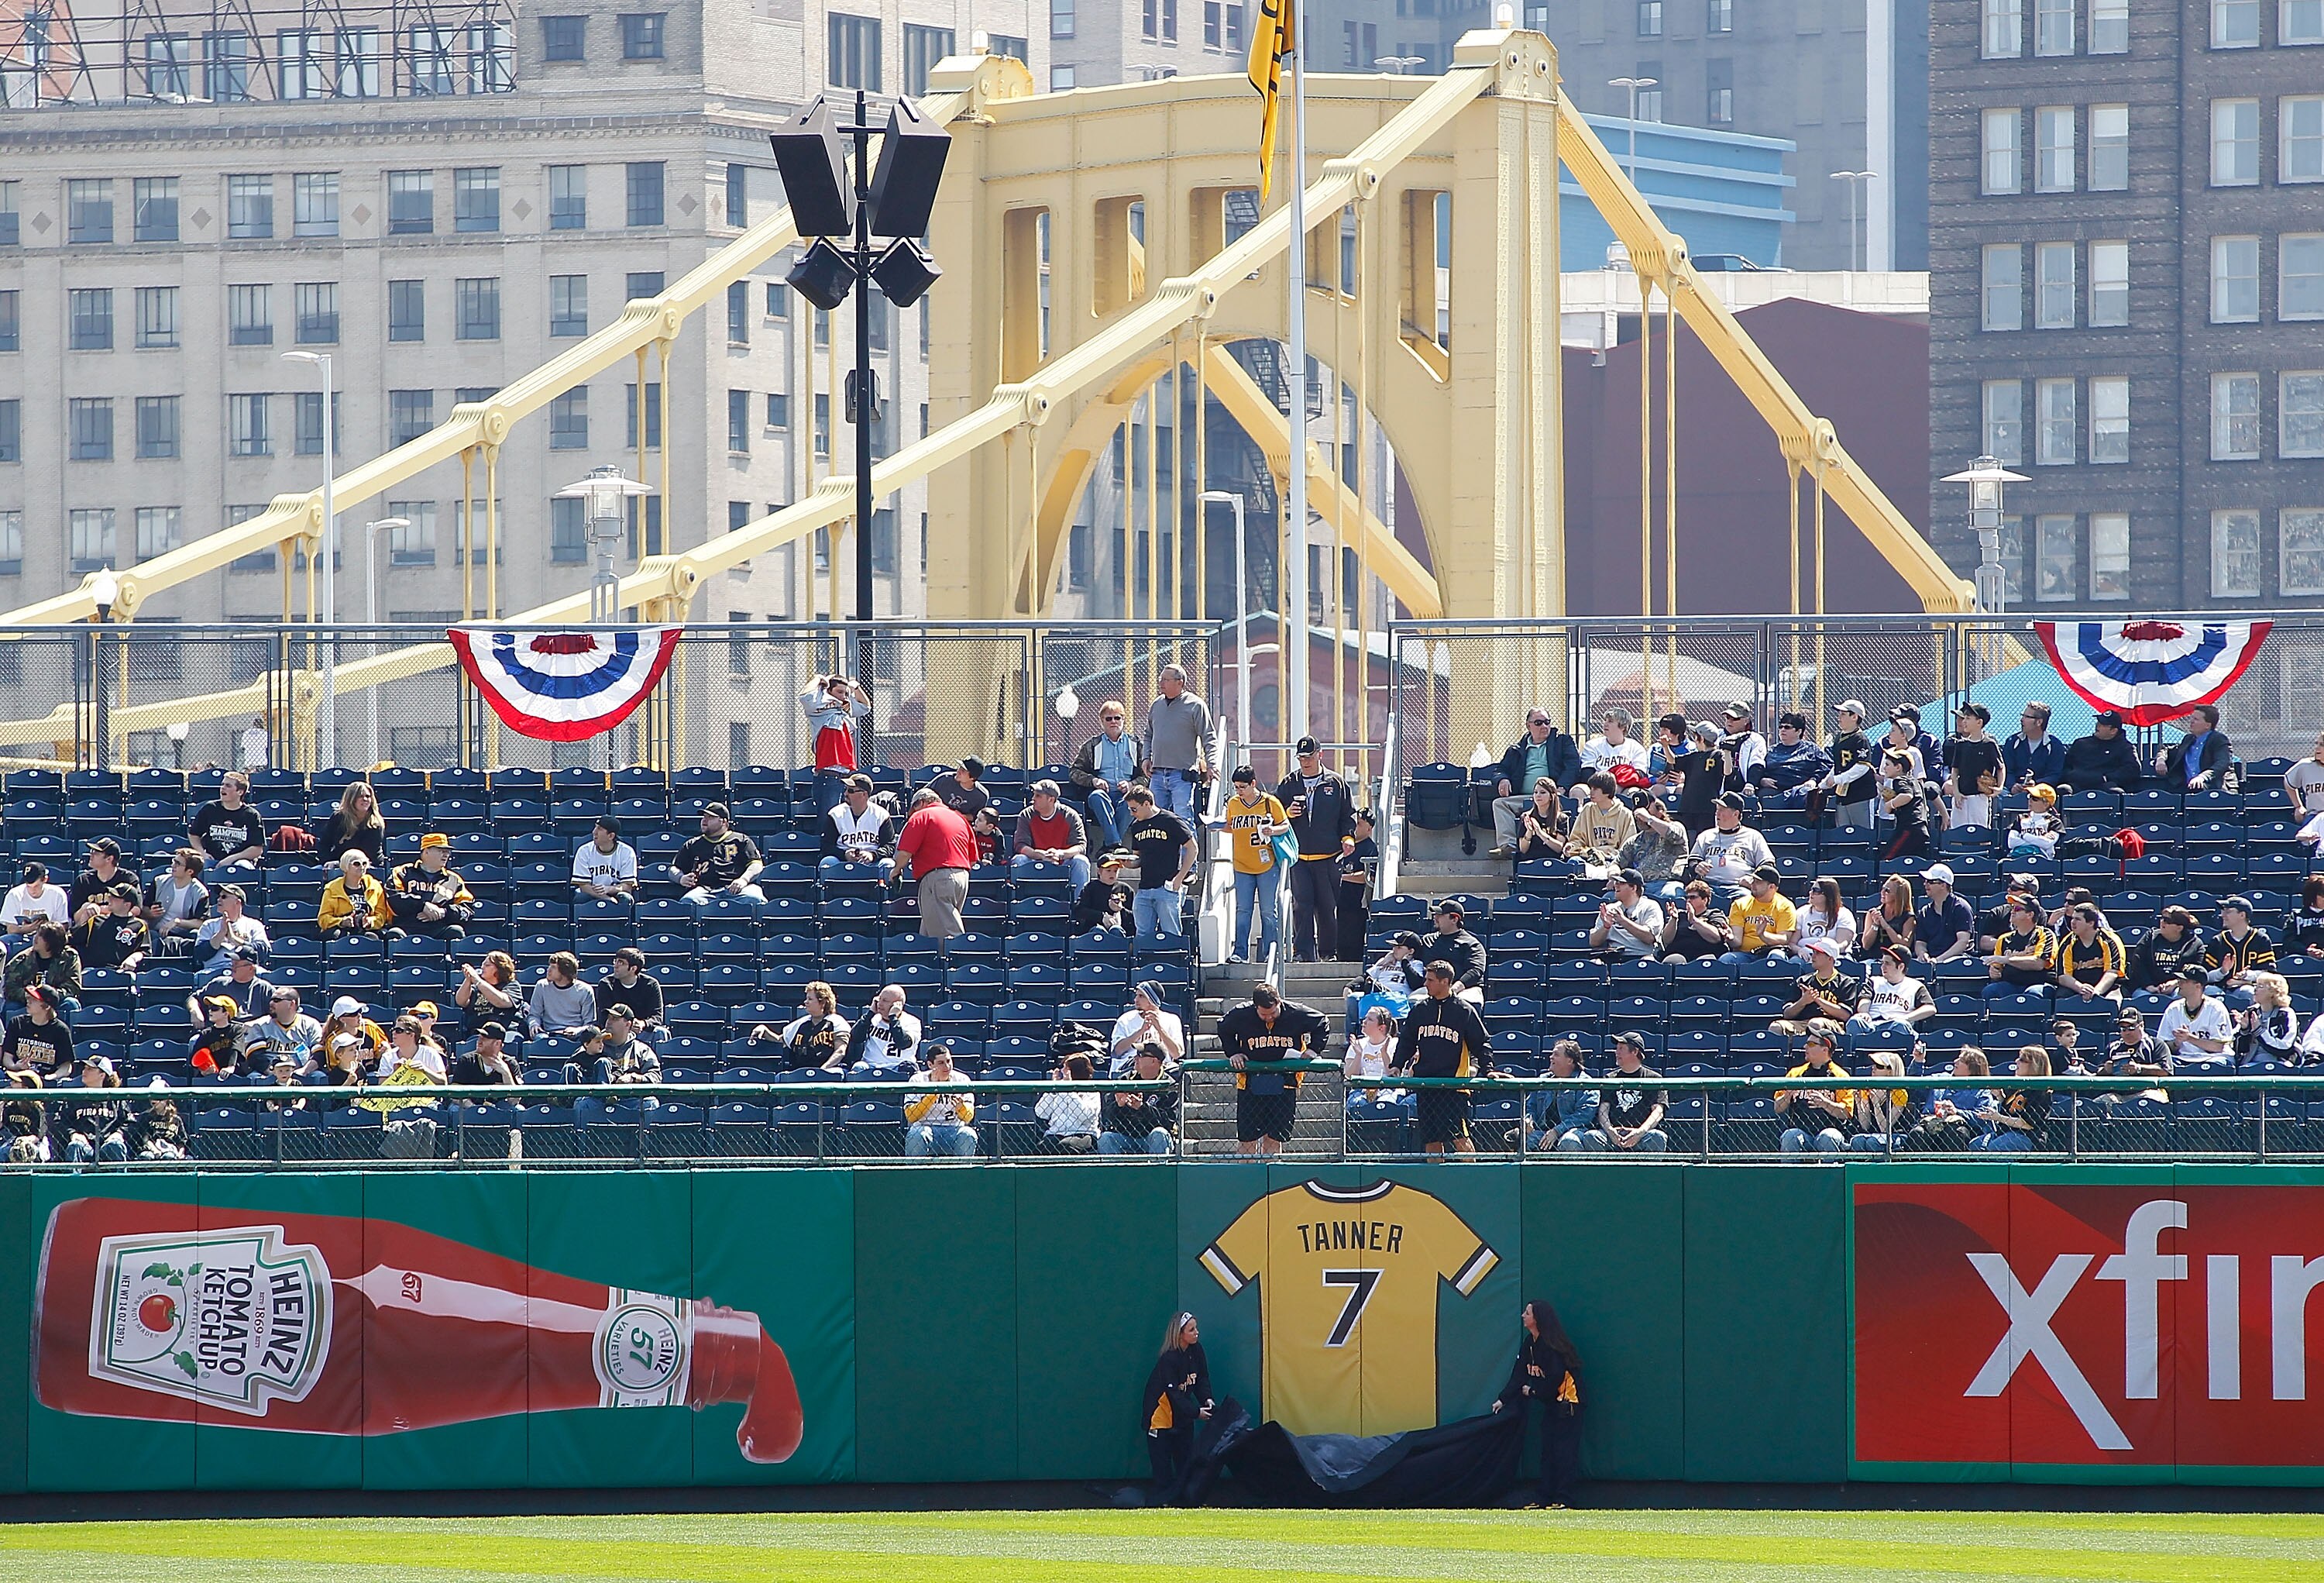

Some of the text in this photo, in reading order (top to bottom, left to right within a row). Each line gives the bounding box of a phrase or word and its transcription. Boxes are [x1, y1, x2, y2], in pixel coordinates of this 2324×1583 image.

[1705, 759, 1715, 771] P
[1841, 750, 1852, 766] P
[1635, 797, 1641, 806] P
[725, 844, 737, 862] P
[2248, 952, 2257, 965] P
[1873, 993, 1909, 1011] IRATES
[1248, 1036, 1294, 1051] PIRATES
[1418, 1024, 1459, 1044] PIRATES
[886, 1043, 901, 1058] 21
[1297, 1221, 1403, 1254] TANNER
[133, 1287, 158, 1306] GROWN
[115, 1274, 131, 1347] NET WT 14 OZ (397g)
[130, 1306, 139, 1322] NOT
[1322, 1268, 1385, 1348] 7
[198, 1267, 226, 1370] KETCHUP
[219, 1264, 255, 1376] TOMATO
[254, 1306, 265, 1334] 1869
[260, 1269, 304, 1374] HEINZ
[610, 1320, 628, 1375] VARIETIES
[630, 1327, 654, 1370] 57
[655, 1327, 674, 1375] HEINZ
